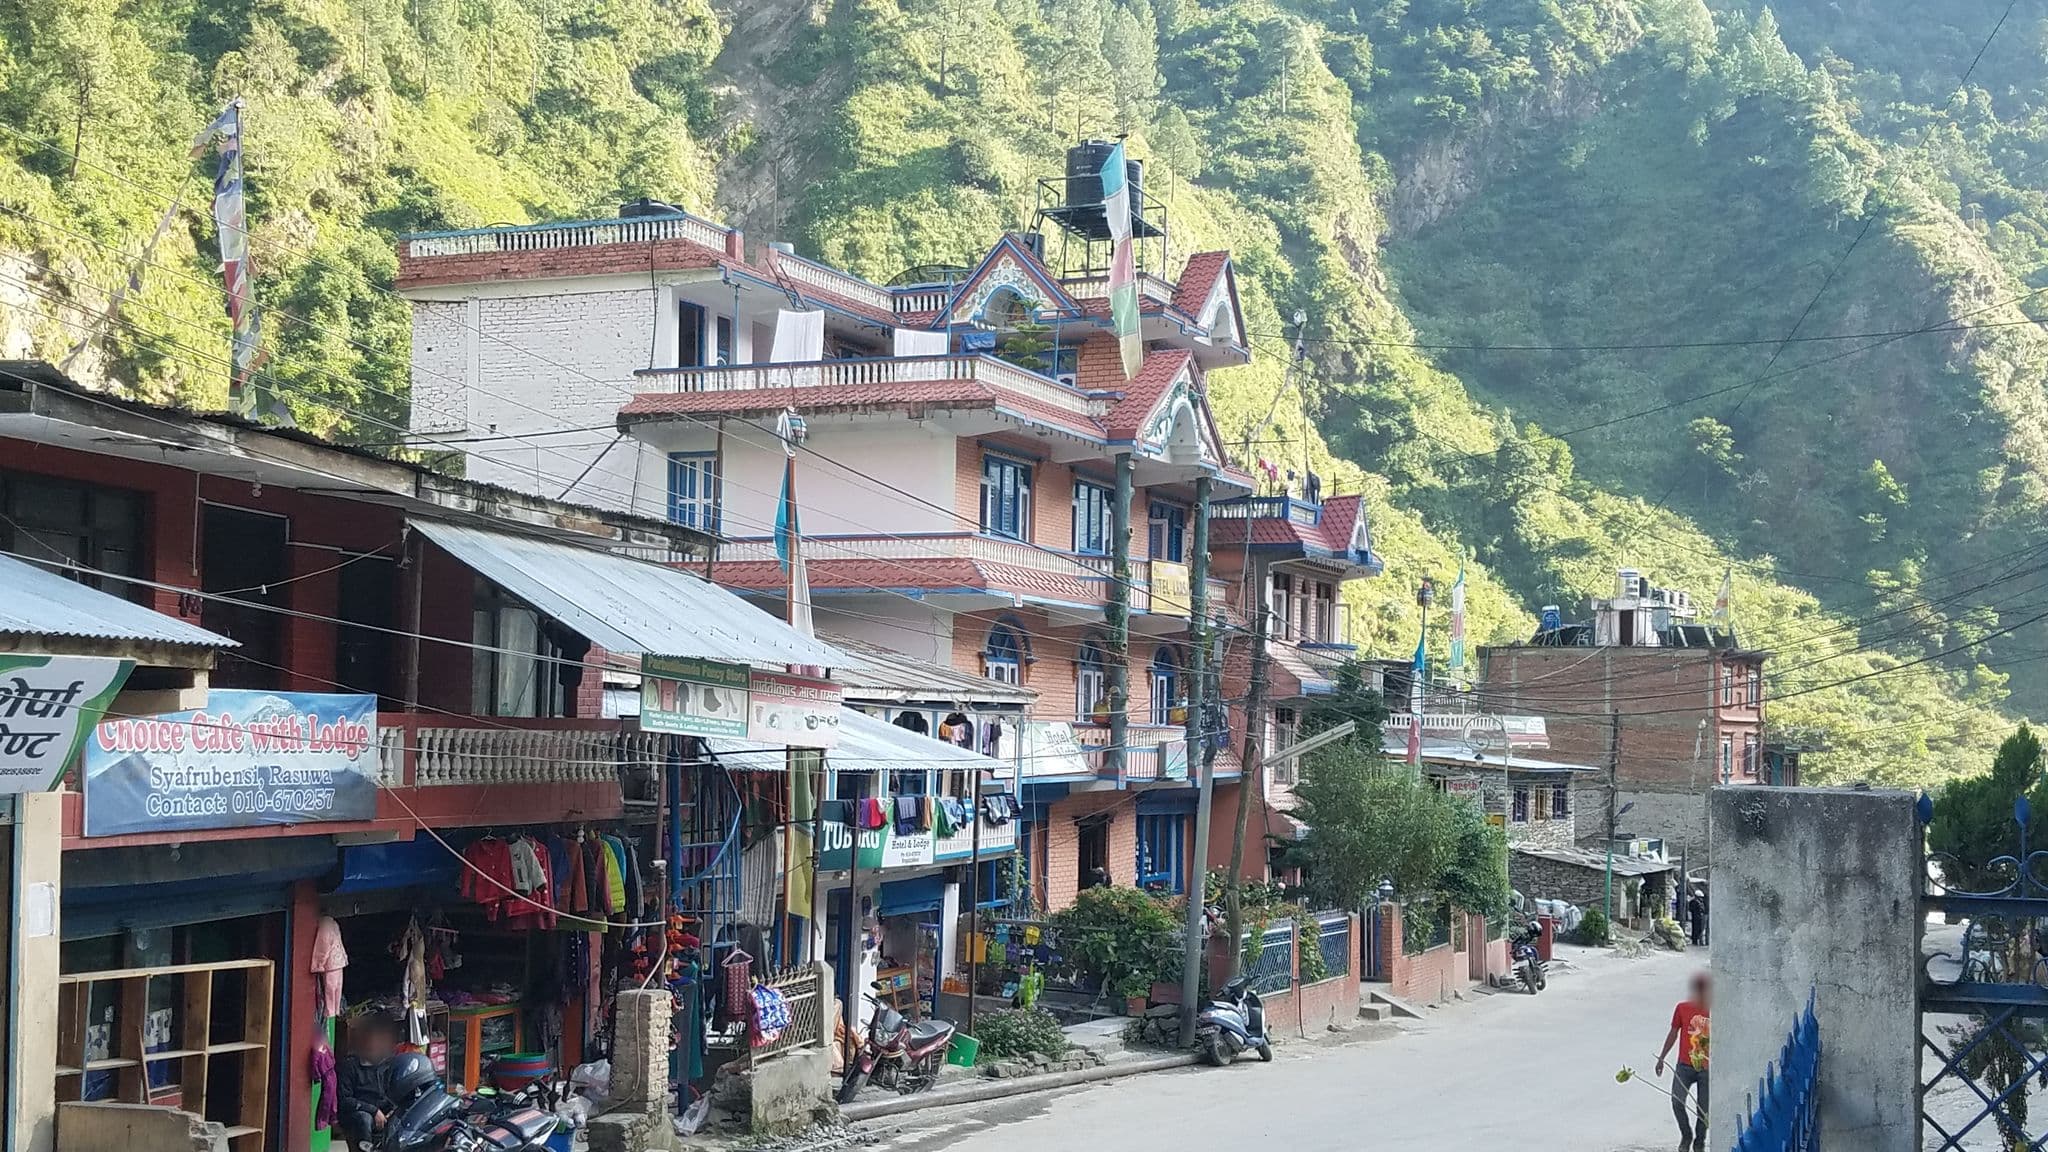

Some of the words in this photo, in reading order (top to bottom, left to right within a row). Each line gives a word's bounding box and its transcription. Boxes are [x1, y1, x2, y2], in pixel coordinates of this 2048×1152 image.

[96, 716, 185, 754] Choice
[191, 712, 244, 753] Cafe
[250, 714, 302, 751] with
[308, 715, 370, 761] Lodge
[1045, 730, 1070, 745] Hotel
[150, 766, 266, 792] Syafrubensi,
[269, 767, 332, 786] Rasuwa
[146, 795, 227, 817] Contact:
[232, 788, 335, 814] 010-670257
[822, 820, 880, 852] TUBRG
[891, 840, 906, 850] Hotel
[907, 840, 912, 849] &
[912, 839, 930, 850] Lodge
